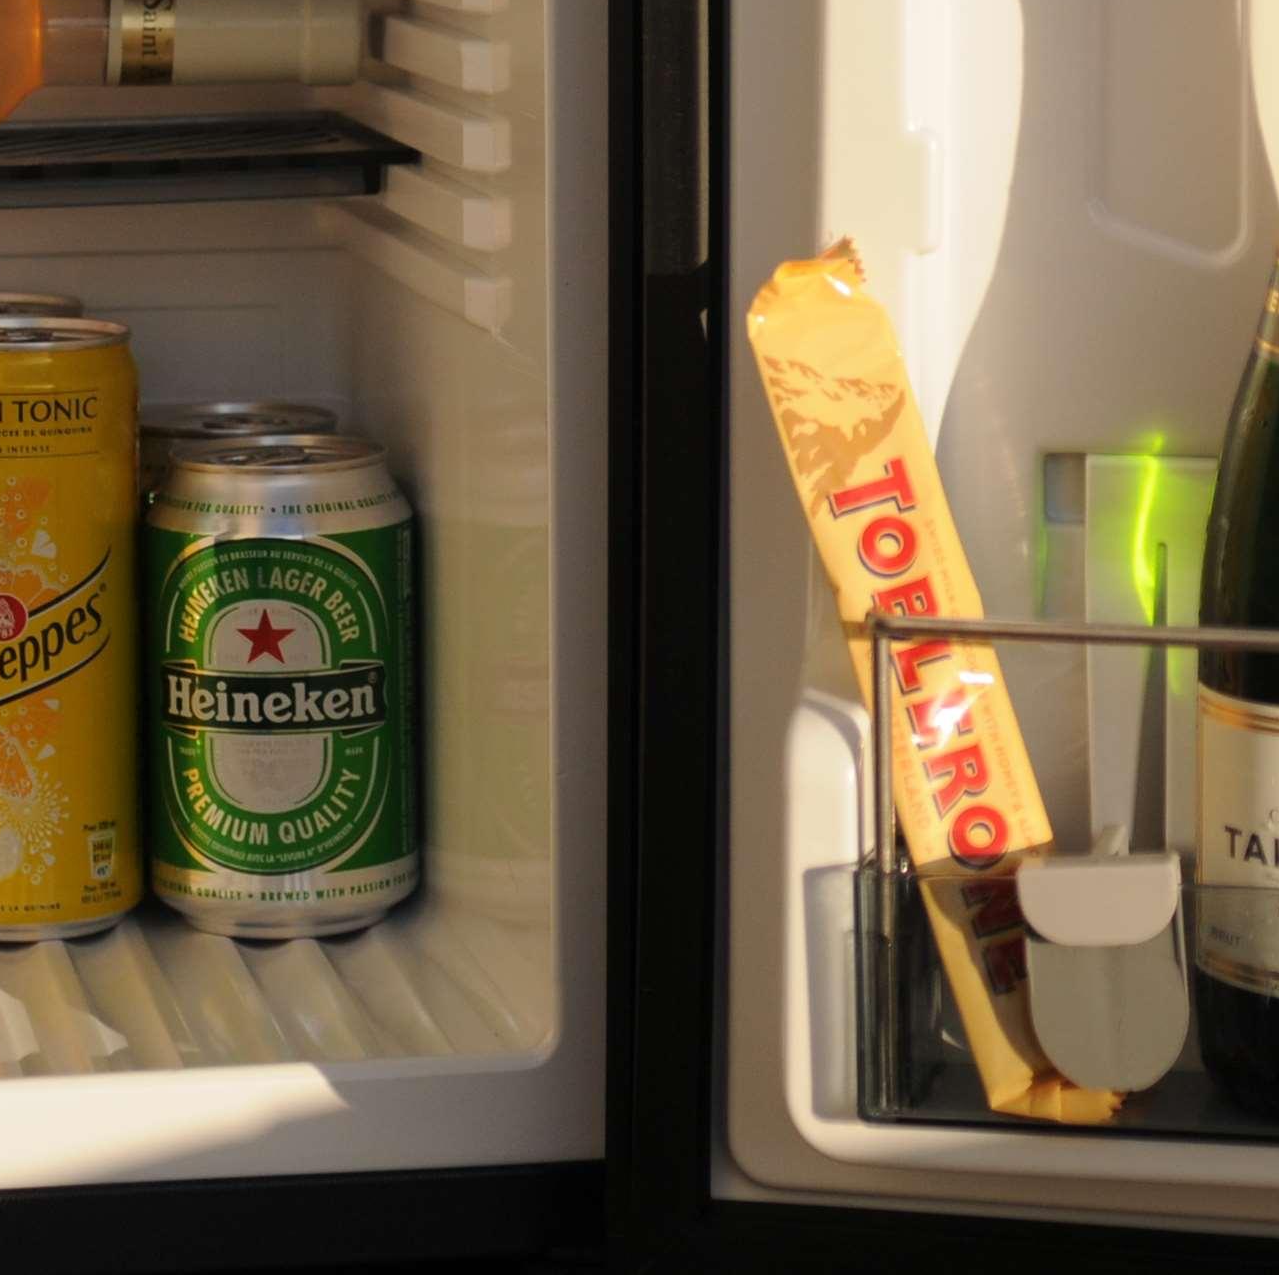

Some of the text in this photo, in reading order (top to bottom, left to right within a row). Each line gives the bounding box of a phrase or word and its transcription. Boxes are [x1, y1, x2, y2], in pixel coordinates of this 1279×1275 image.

[11, 395, 99, 423] TONIC
[6, 444, 51, 454] INTENSE
[179, 566, 361, 643] HEINEKEN LAGER BEER
[168, 675, 376, 724] Heineken
[183, 768, 269, 846] PREMIUM
[278, 768, 361, 844] QUALITY
[315, 886, 347, 900] WITH
